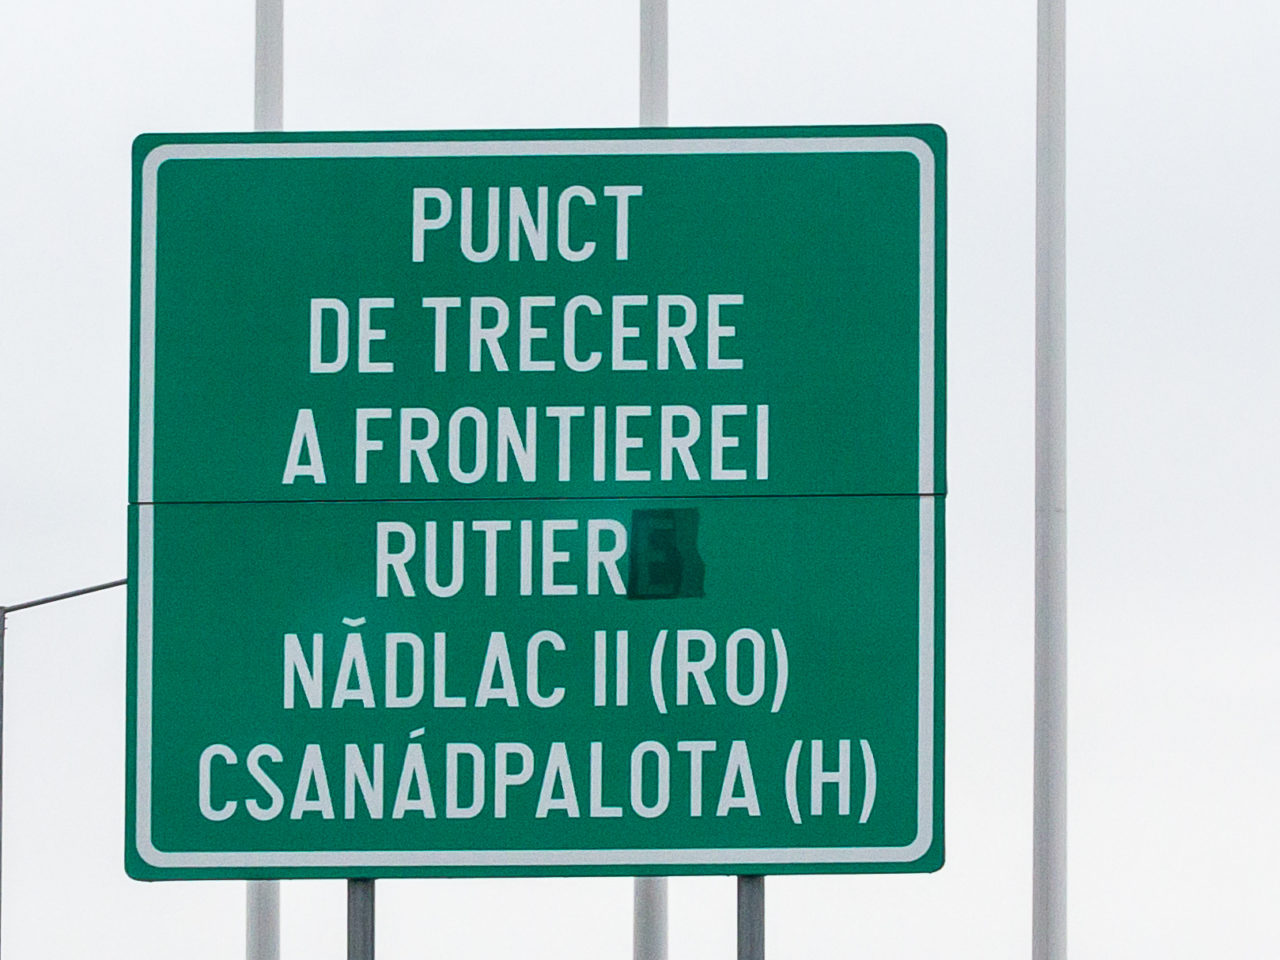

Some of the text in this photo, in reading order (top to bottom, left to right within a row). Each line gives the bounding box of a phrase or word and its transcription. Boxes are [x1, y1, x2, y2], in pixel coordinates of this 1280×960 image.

[411, 185, 643, 263] PUNCT
[310, 294, 744, 373] DE TRECERE
[282, 404, 769, 484] A FRONTIEREI
[283, 617, 789, 714] NĂDLAC II (RO)
[199, 728, 877, 824] CSANÁDPALOTA (H)
